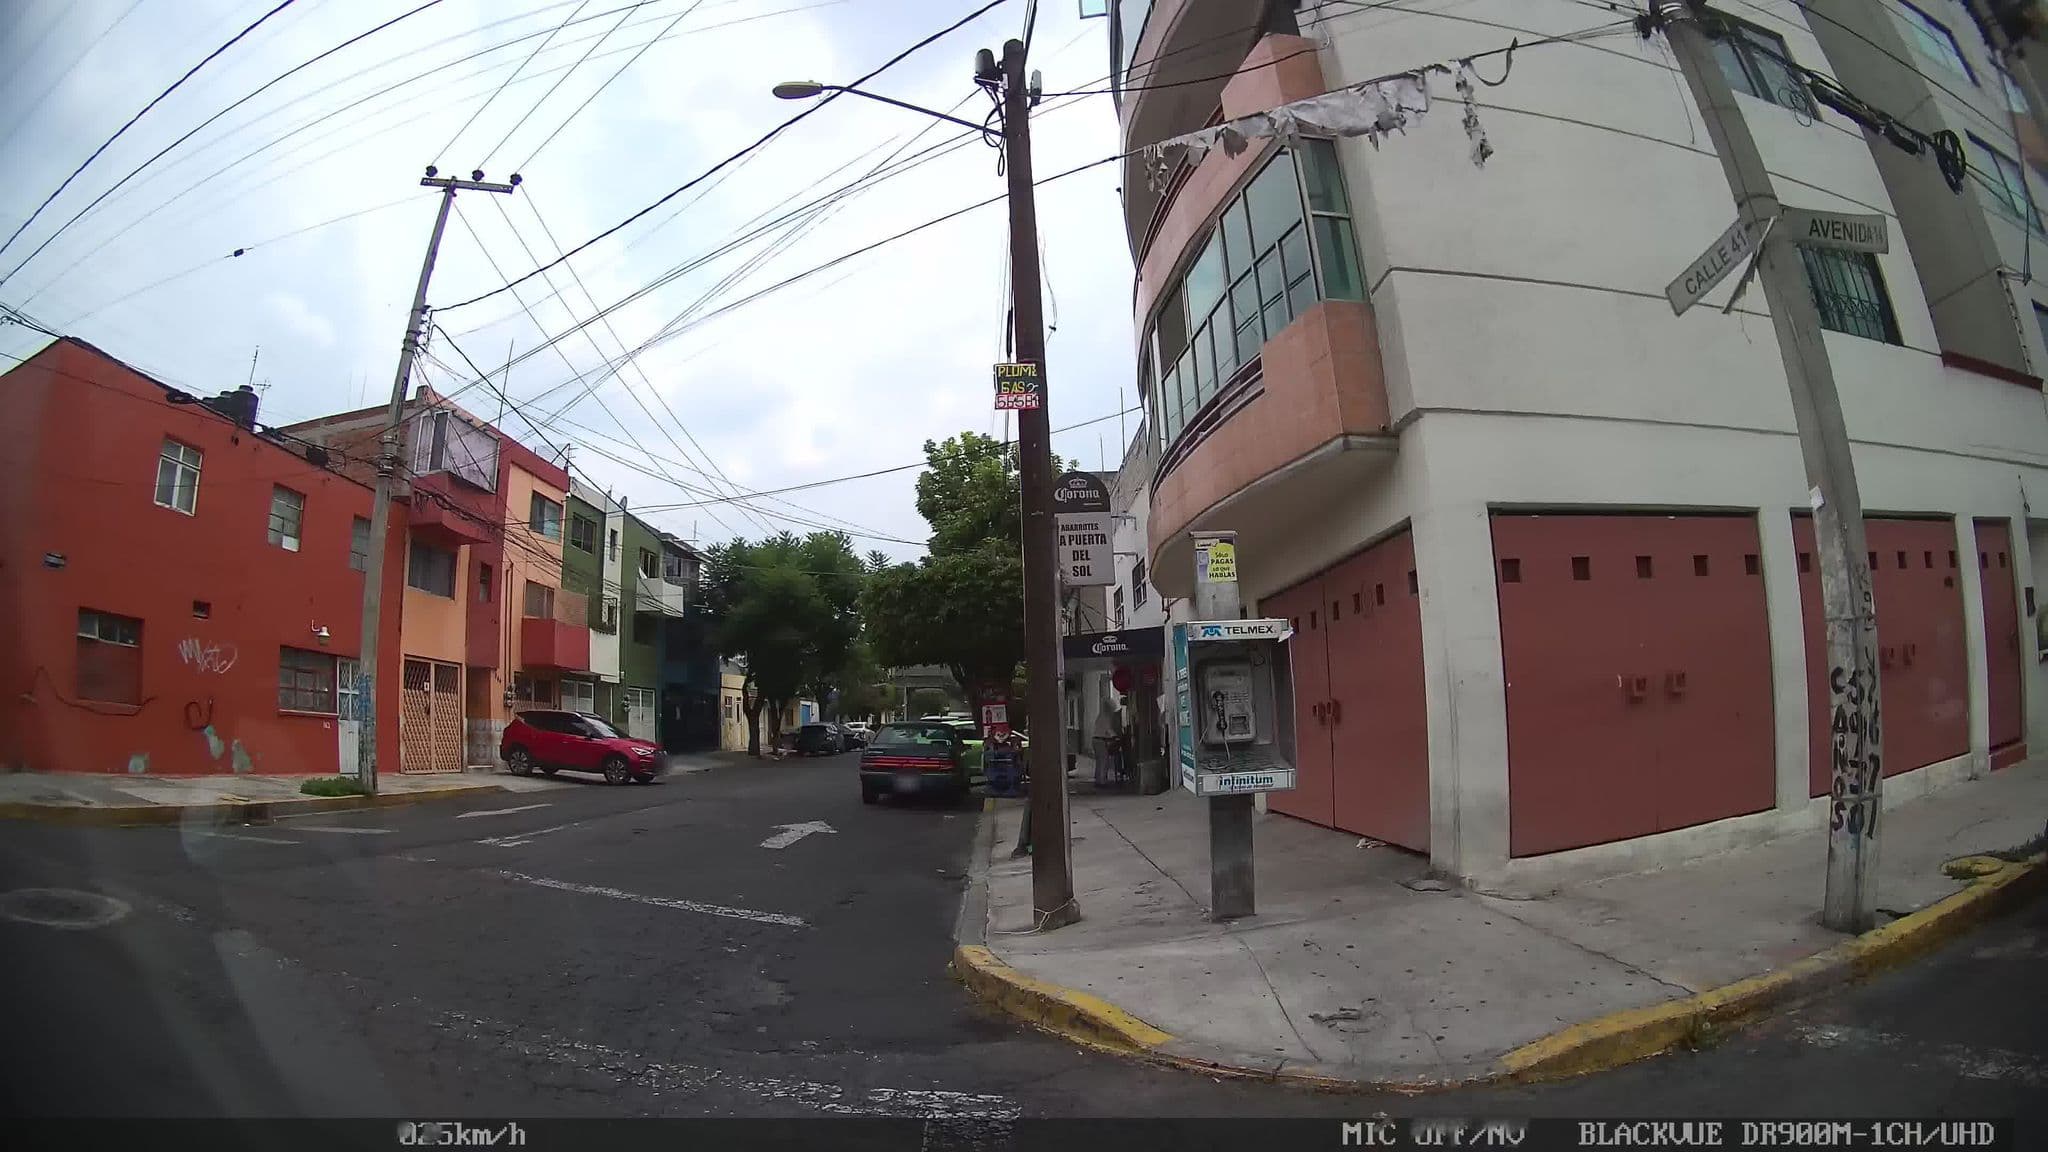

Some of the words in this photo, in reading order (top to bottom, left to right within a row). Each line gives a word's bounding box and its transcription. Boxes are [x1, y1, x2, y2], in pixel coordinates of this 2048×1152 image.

[1808, 217, 1873, 244] AVENIDA
[1685, 246, 1731, 294] CALLE
[1731, 229, 1747, 252] 41
[1054, 487, 1101, 503] Corona
[1060, 522, 1100, 532] ABARROTES
[1068, 533, 1107, 546] PUERTA
[1072, 549, 1091, 561] DEL
[1072, 565, 1092, 577] SOL
[1208, 571, 1236, 579] HABLAS
[1224, 625, 1274, 635] TELMEX
[1091, 642, 1127, 655] Corona
[1219, 773, 1274, 787] infinitum
